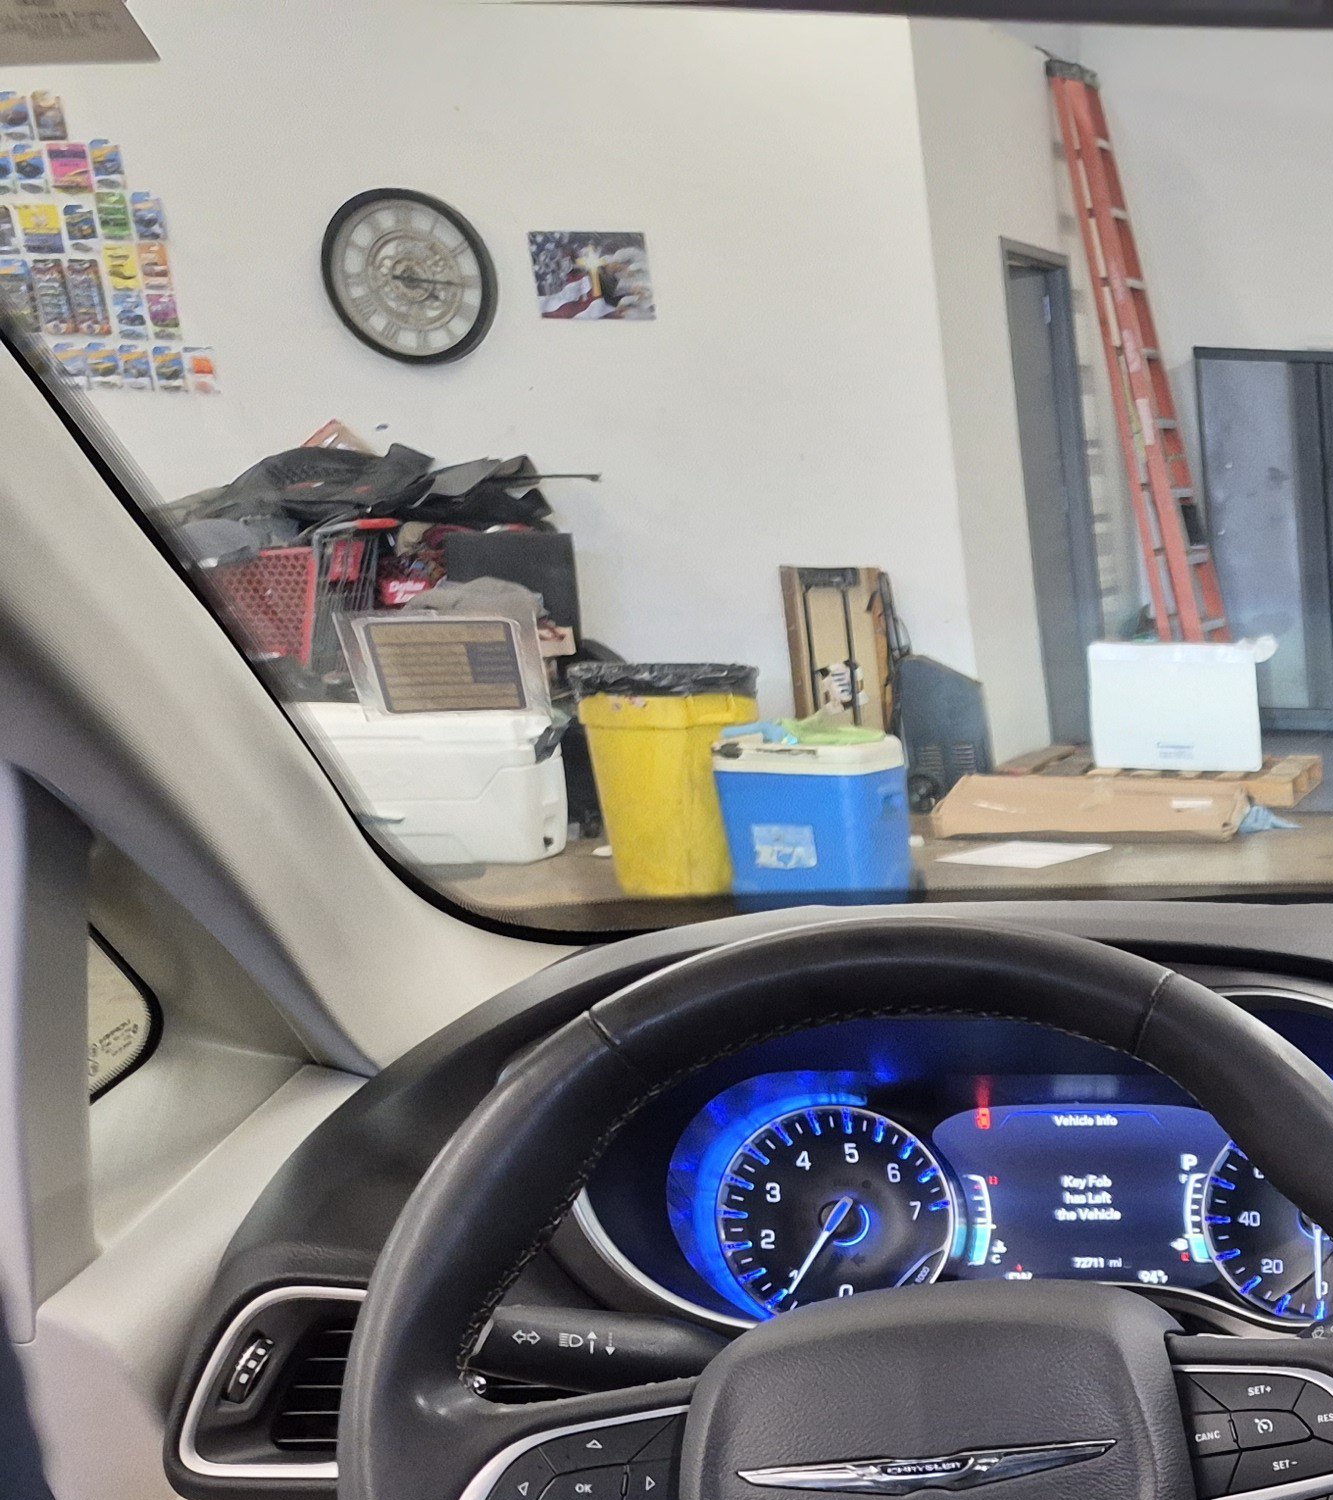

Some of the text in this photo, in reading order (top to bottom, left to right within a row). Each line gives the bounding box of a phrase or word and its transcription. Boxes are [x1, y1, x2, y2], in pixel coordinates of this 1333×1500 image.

[1053, 1113, 1119, 1126] Vehicle Info
[795, 1151, 812, 1171] 4
[843, 1143, 860, 1163] 5
[1181, 1154, 1199, 1171] P
[886, 1163, 901, 1183] 6
[1061, 1175, 1113, 1190] Key Fob
[765, 1182, 781, 1203] 3
[1062, 1191, 1113, 1205] has Left
[909, 1201, 922, 1221] 7
[1055, 1207, 1122, 1222] the Vehicle
[1238, 1210, 1261, 1227] 40
[760, 1229, 776, 1249] 2
[1260, 1258, 1284, 1274] 20
[1194, 1430, 1221, 1443] CANC
[886, 1461, 962, 1475] CHRYSLER
[574, 1482, 593, 1494] OK
